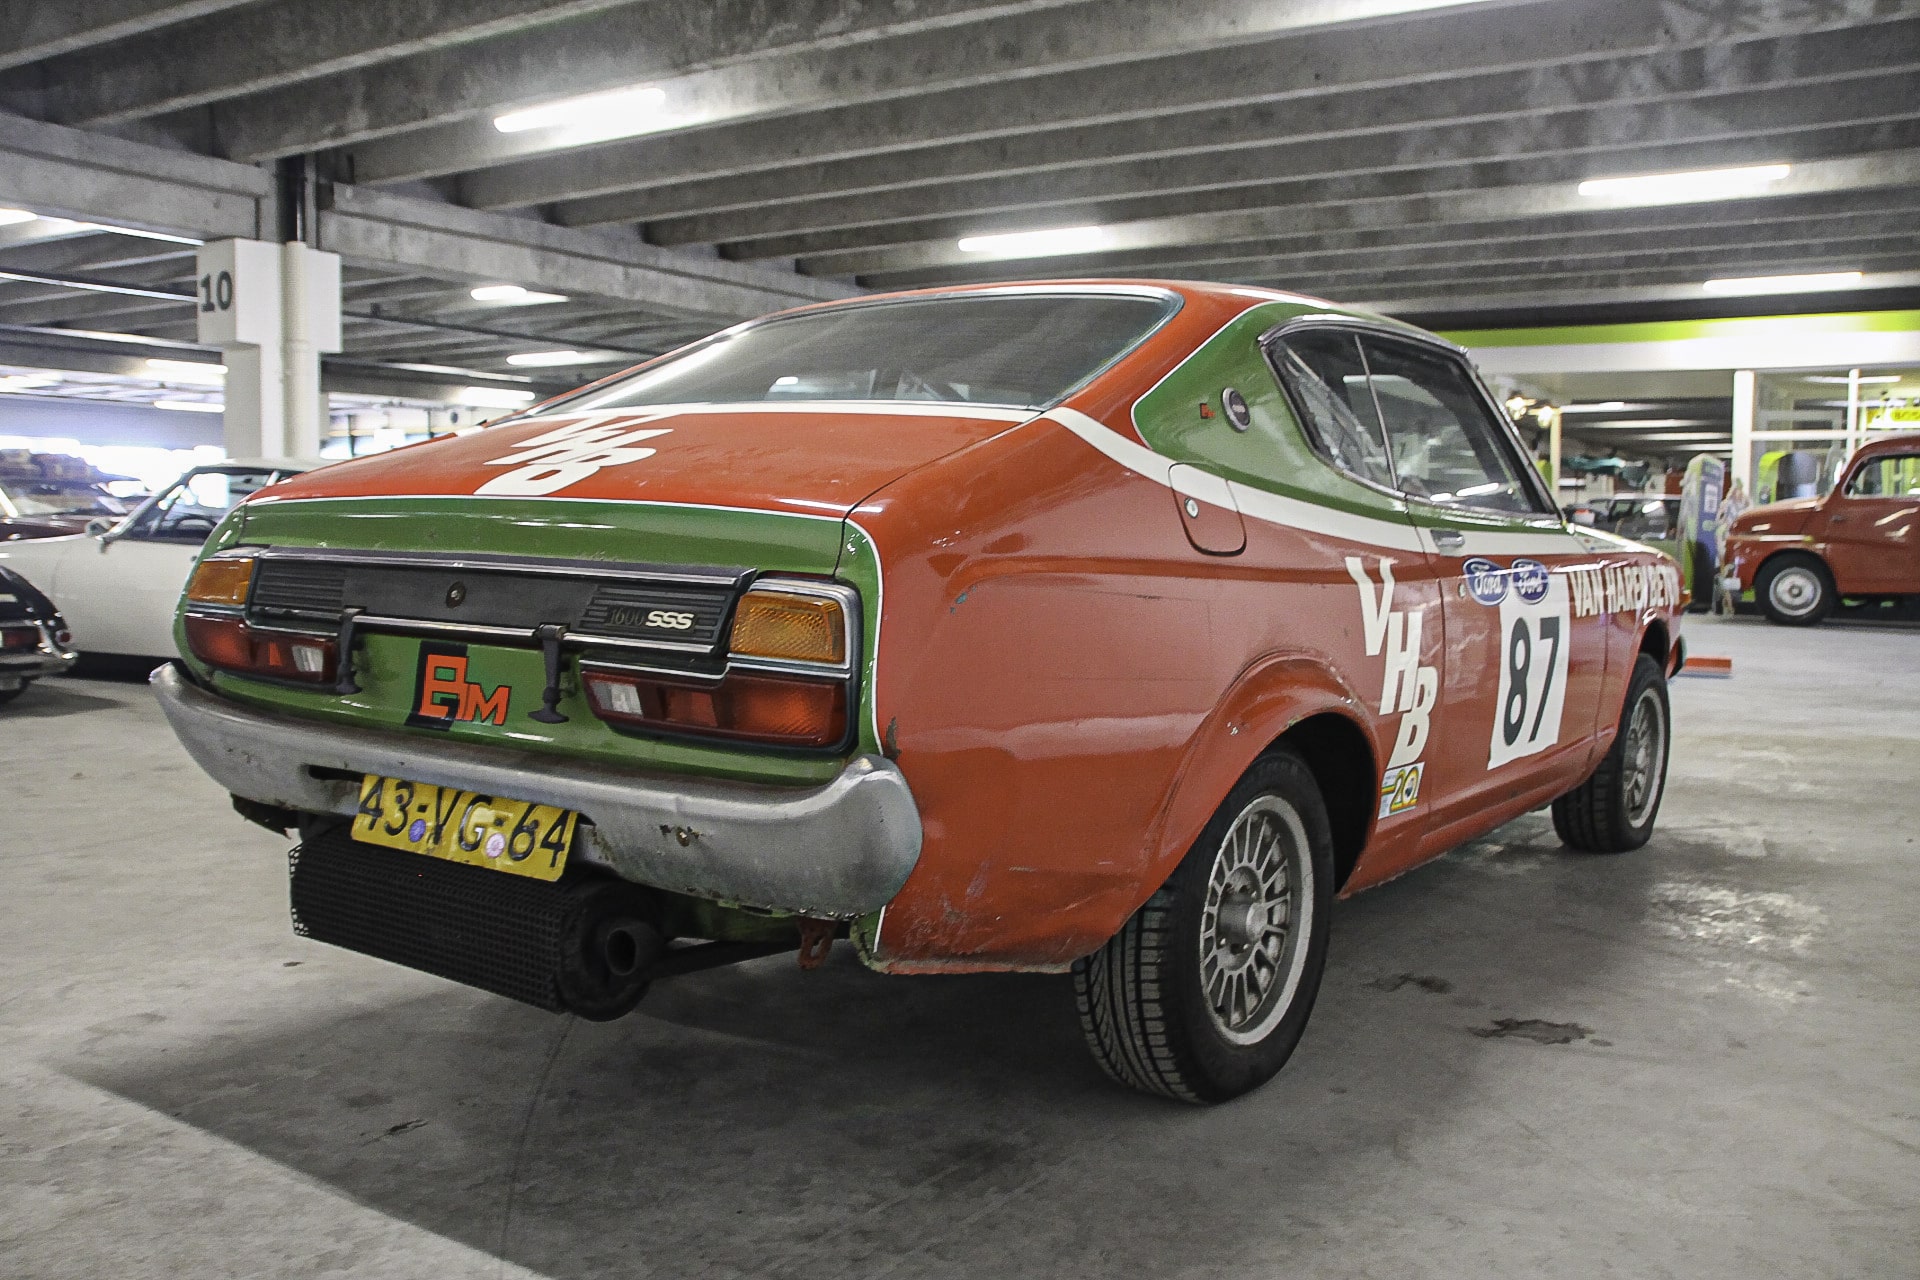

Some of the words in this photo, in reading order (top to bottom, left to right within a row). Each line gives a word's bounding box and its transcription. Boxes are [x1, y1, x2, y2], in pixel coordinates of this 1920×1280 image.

[200, 271, 233, 312] 10
[1569, 568, 1604, 618] VAN
[645, 610, 695, 630] SSS
[1344, 556, 1438, 770] VHB
[1503, 616, 1560, 747] 87
[1390, 766, 1419, 814] 20
[358, 776, 567, 868] 43-VG-64
